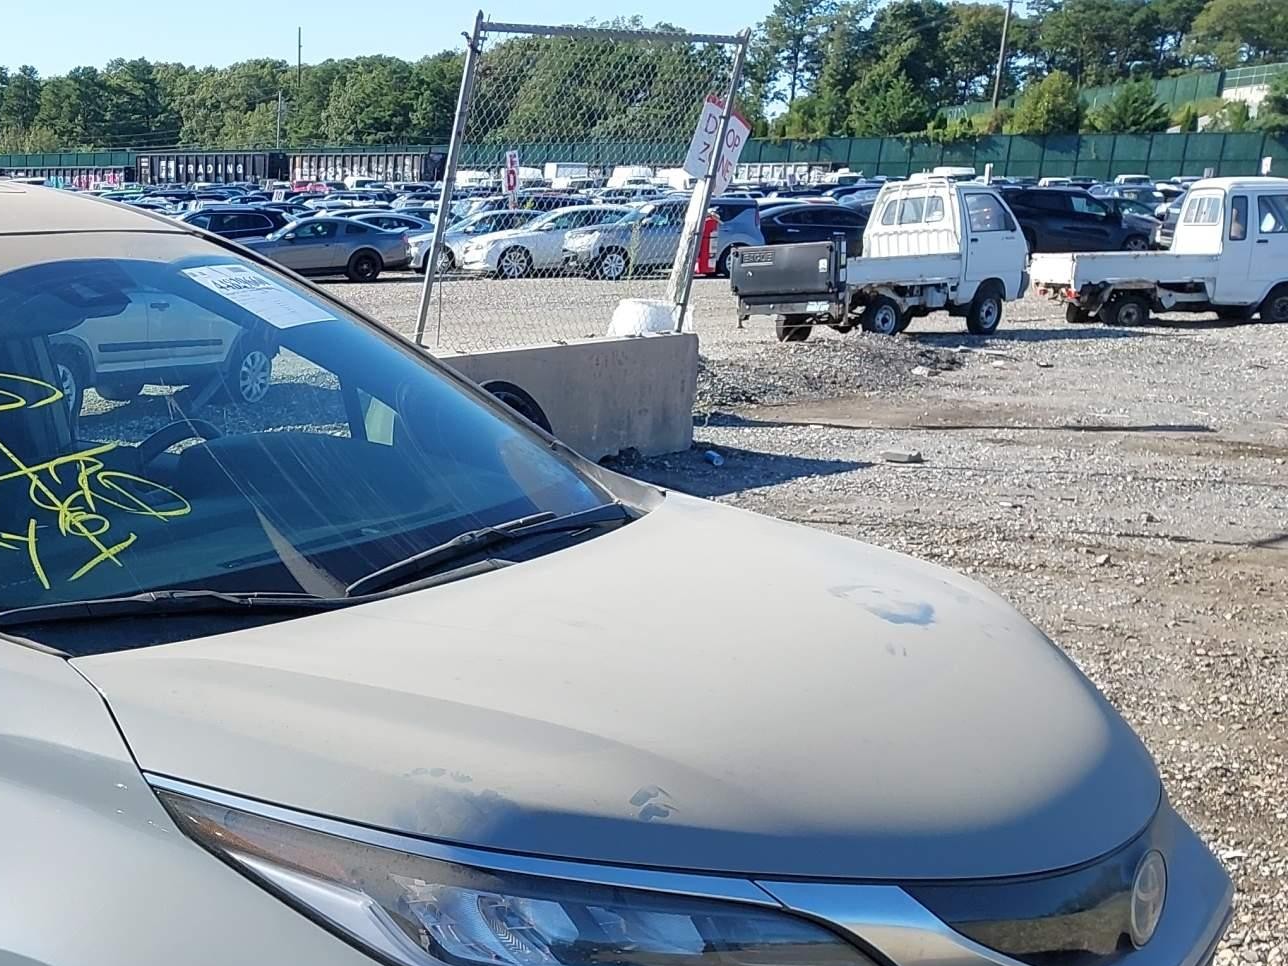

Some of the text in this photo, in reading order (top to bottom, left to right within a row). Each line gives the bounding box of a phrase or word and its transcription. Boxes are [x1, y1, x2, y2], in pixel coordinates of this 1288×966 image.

[705, 113, 741, 153] DOP
[178, 164, 244, 174] TRADING
[698, 141, 733, 182] ZNE
